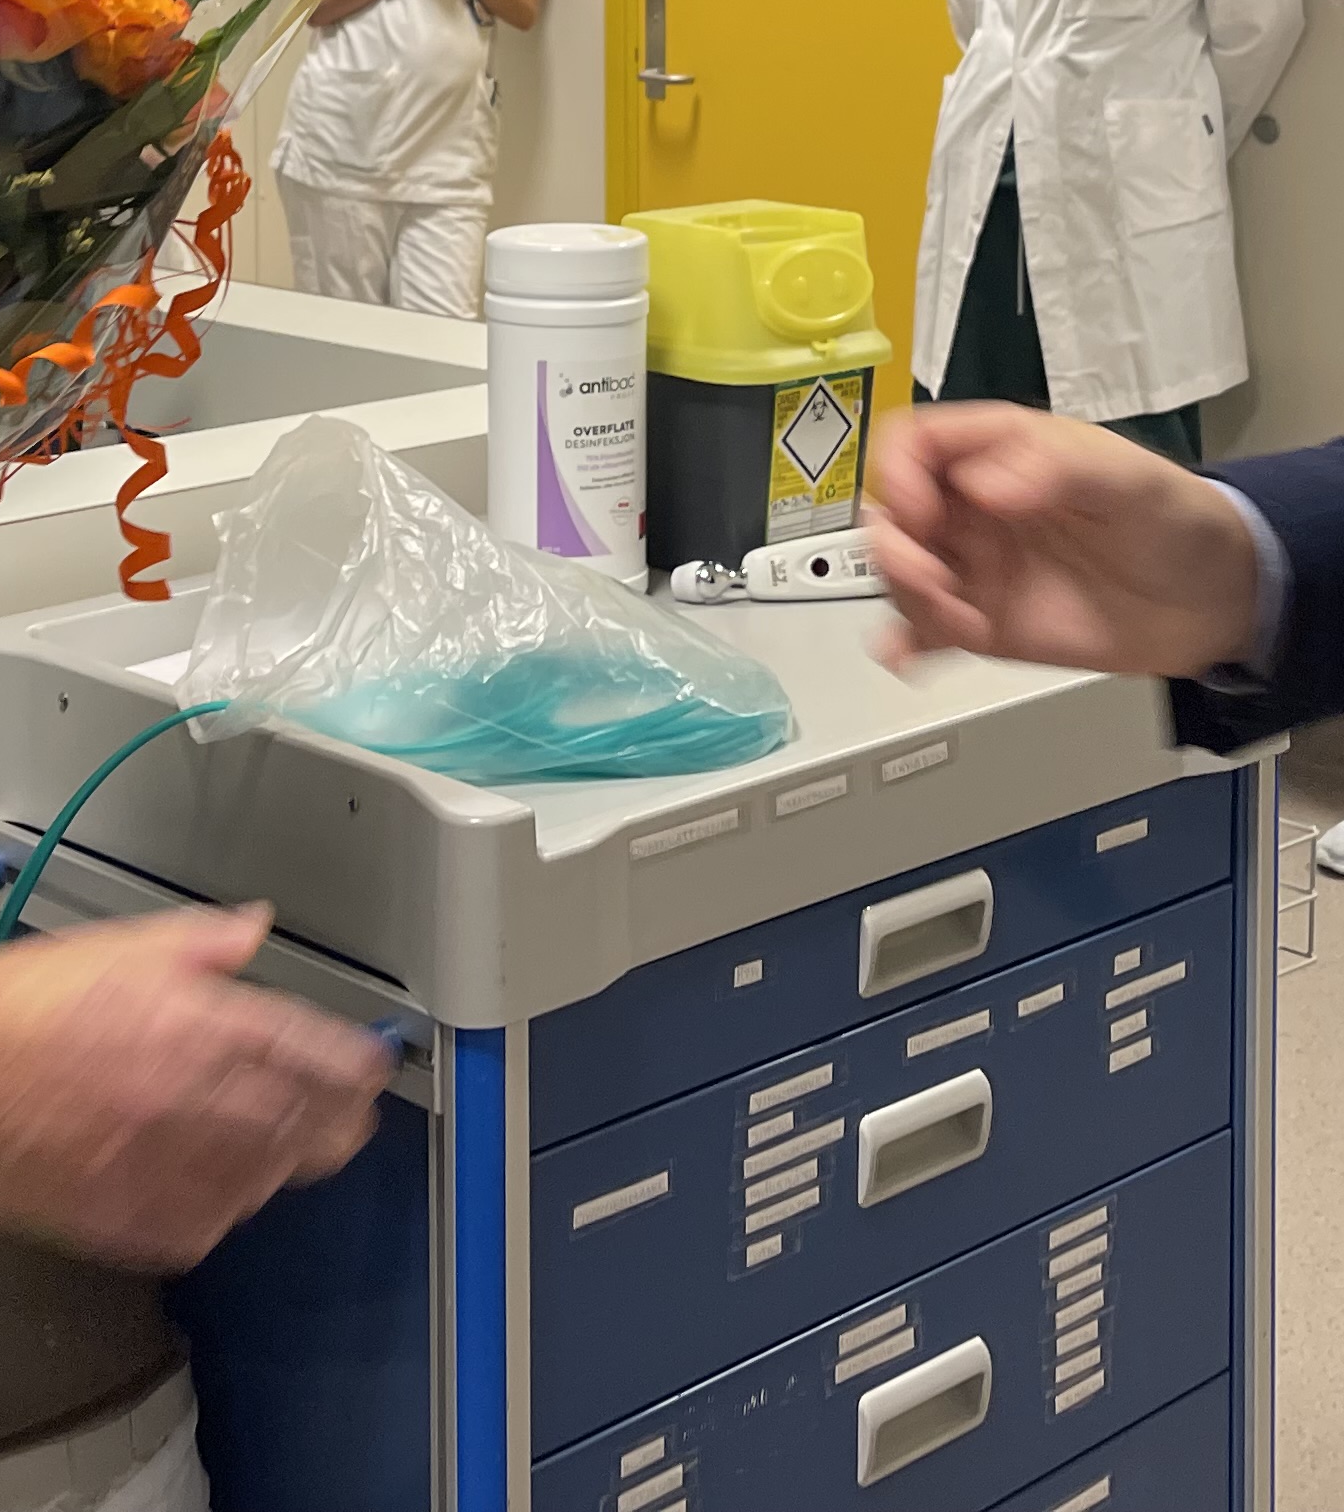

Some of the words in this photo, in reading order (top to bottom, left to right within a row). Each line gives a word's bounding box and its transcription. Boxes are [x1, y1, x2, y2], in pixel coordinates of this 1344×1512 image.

[579, 374, 635, 394] antibac
[573, 419, 635, 437] OVERFLATE
[564, 433, 635, 450] DESINFEKSJON
